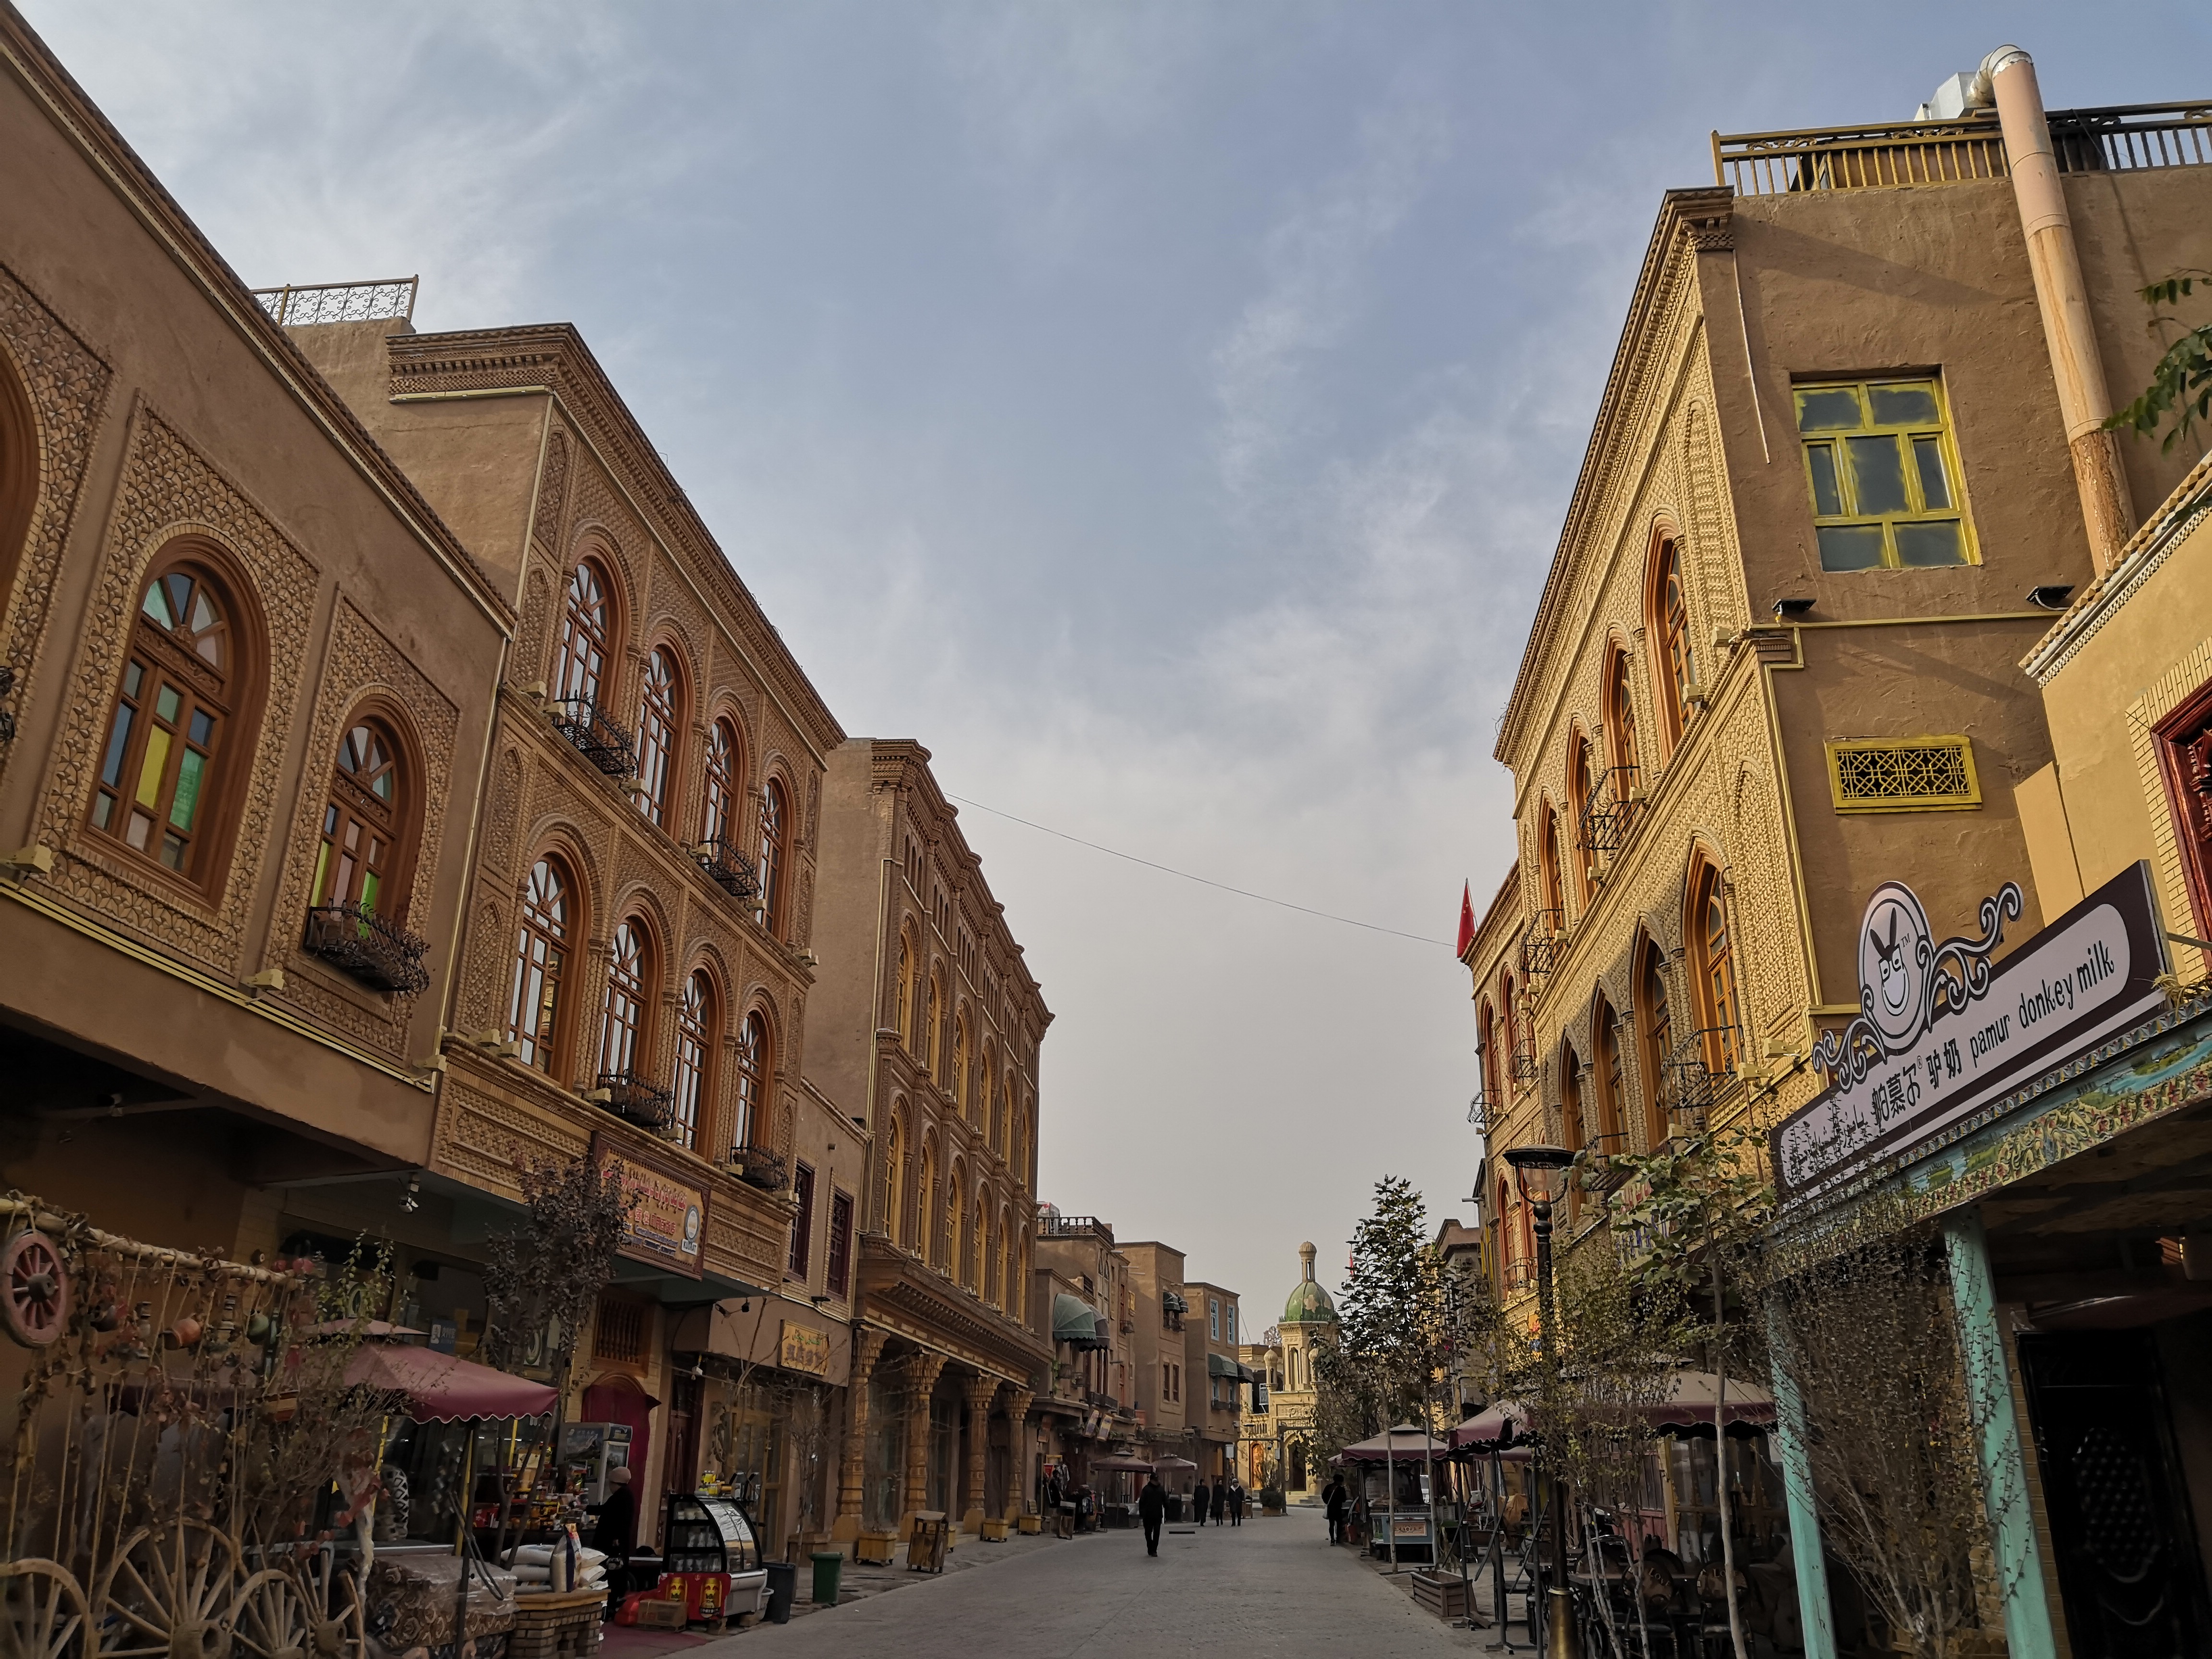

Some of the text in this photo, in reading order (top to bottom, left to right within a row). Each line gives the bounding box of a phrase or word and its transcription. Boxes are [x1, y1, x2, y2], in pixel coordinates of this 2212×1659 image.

[1970, 939, 2115, 1069] pamur donkey milk
[1925, 1037, 1962, 1090] 驴奶
